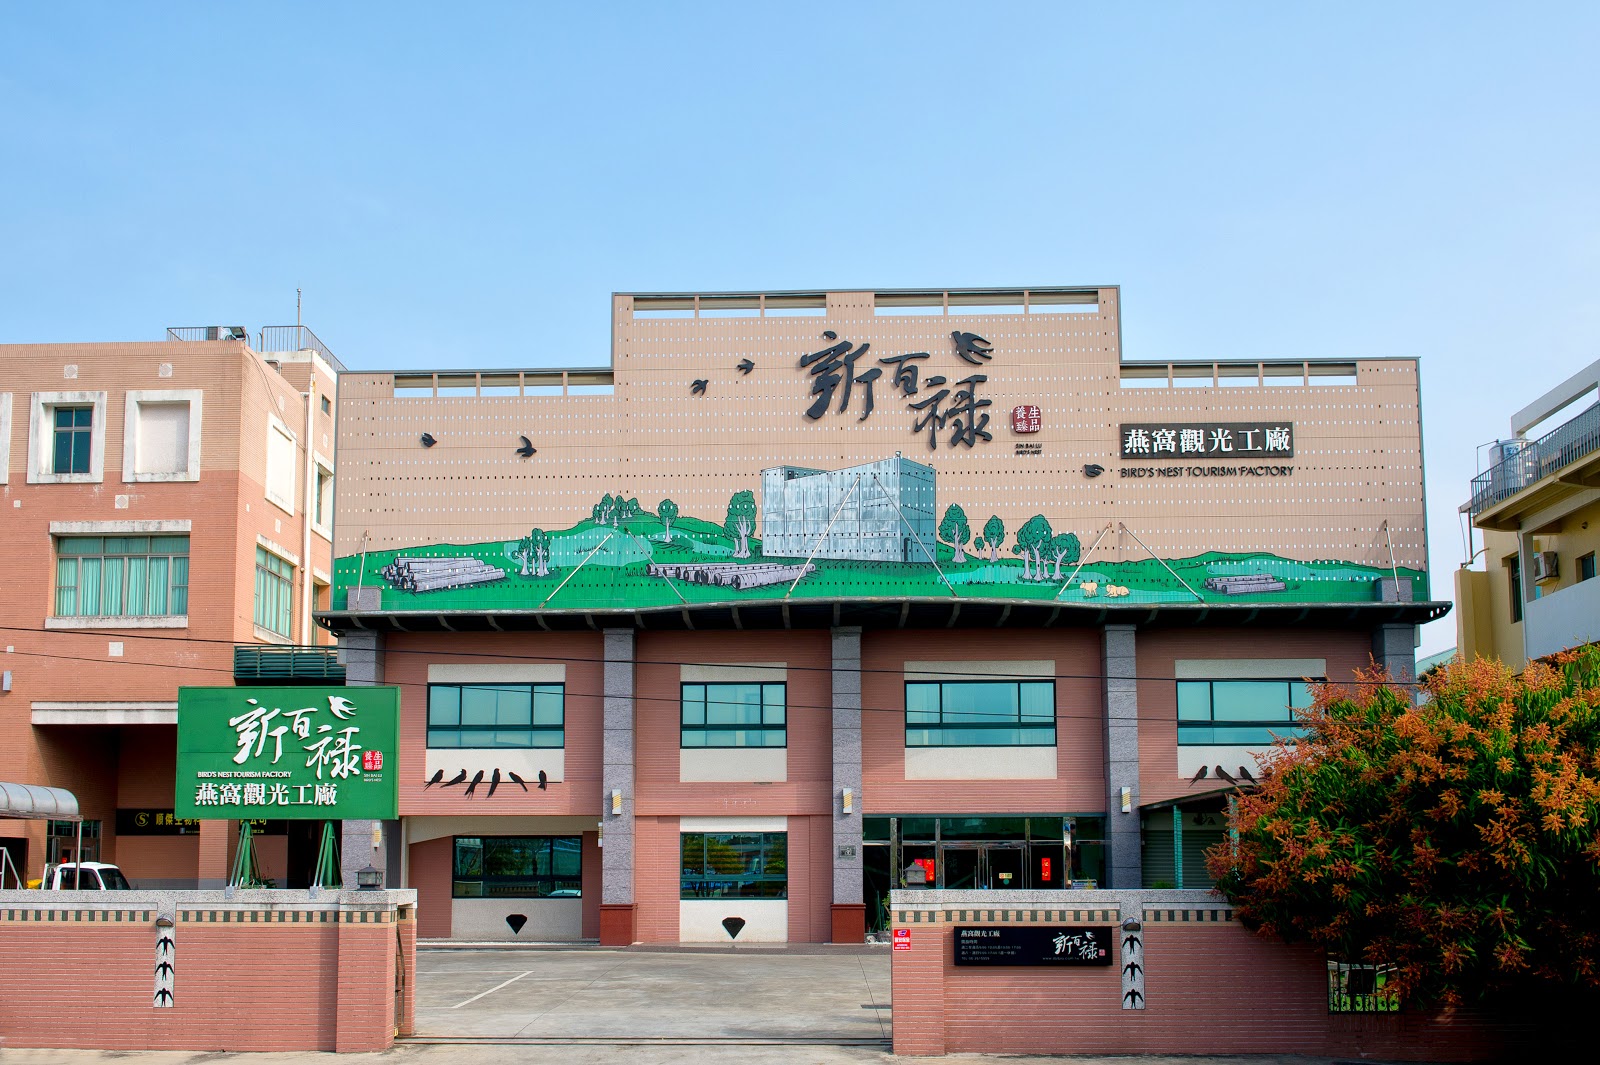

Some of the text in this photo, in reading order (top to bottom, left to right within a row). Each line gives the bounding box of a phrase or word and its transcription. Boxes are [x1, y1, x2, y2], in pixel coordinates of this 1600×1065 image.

[1124, 427, 1291, 453] 燕窩觀光工廠
[1121, 466, 1294, 478] BIRD'S NEST TOURISM FACTORY
[195, 782, 338, 806] 燕窩觀光工廠
